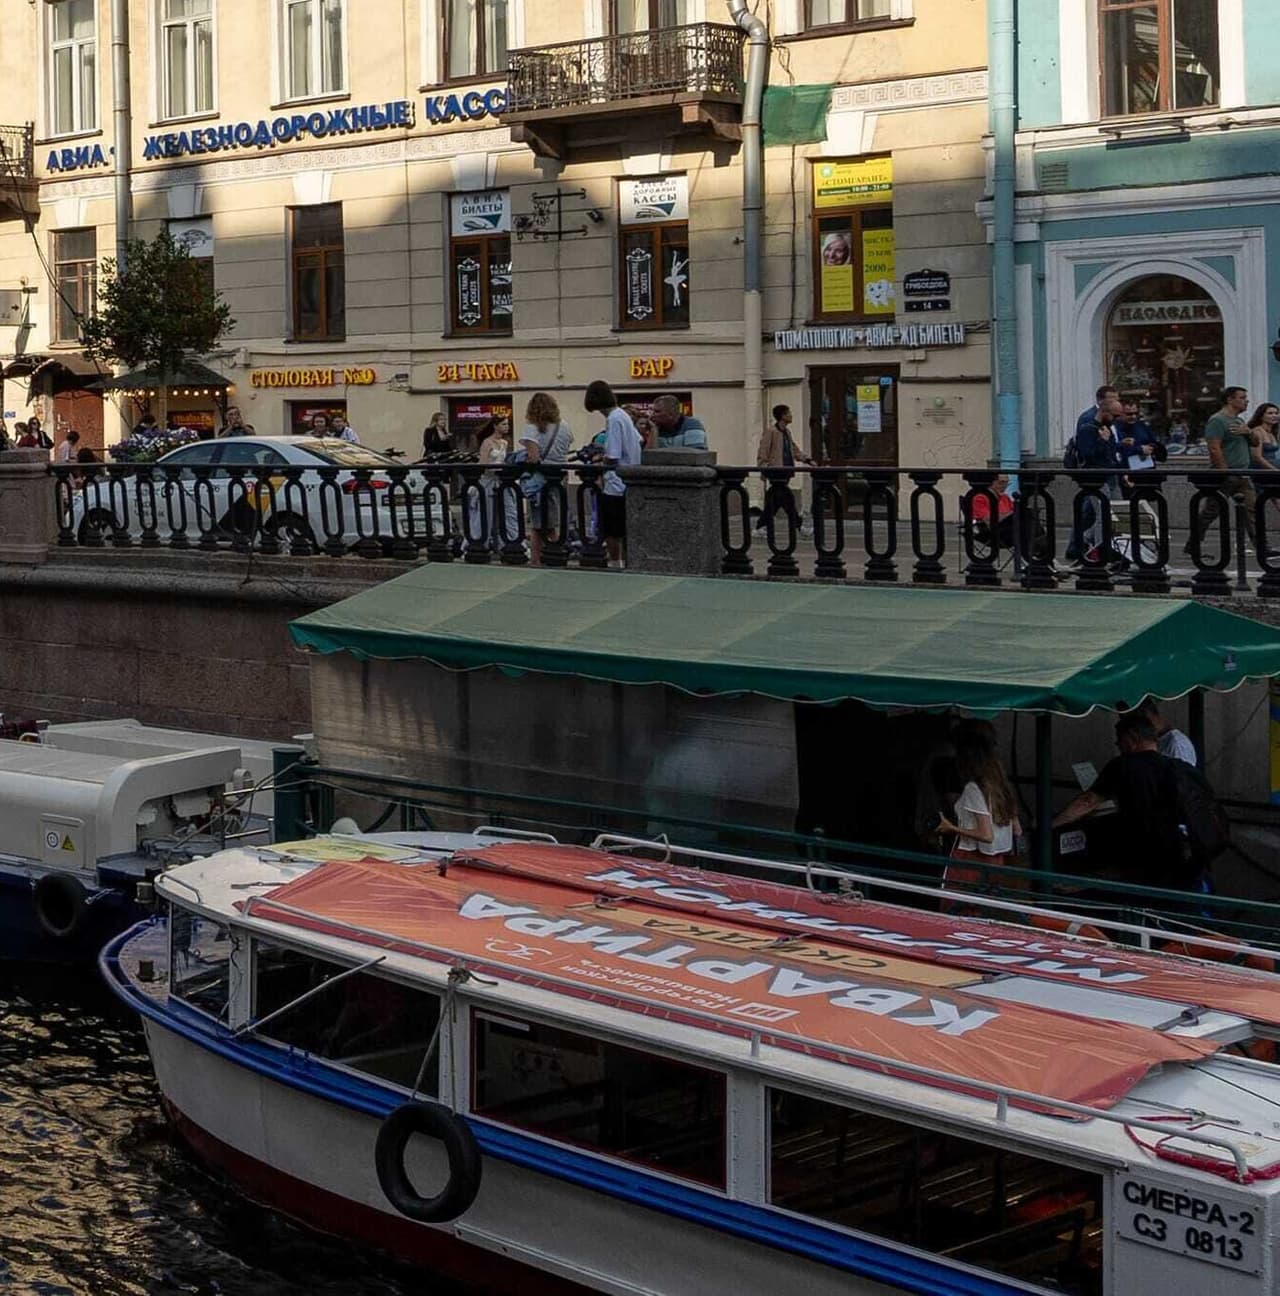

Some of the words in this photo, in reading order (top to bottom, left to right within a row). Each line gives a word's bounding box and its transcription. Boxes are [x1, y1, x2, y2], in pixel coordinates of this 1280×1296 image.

[143, 100, 415, 160] ЖЕЛЕЗНОДОРОЖНЫЕ
[462, 193, 503, 205] АВИА
[462, 203, 503, 215] БИЛЕТЫ
[633, 193, 677, 205] КАССЫ
[923, 302, 932, 310] 14
[774, 328, 855, 350] СТОМАТОЛОГИЯ
[919, 324, 965, 345] БИЛЕТЫ
[249, 367, 335, 388] СТОЛОВАЯ
[437, 363, 460, 383] 24
[465, 360, 520, 382] ЧАСА
[629, 356, 674, 378] БАР
[585, 870, 1150, 983] МИЛЛИОН
[643, 919, 887, 968] СКИДКА
[459, 894, 1001, 1037] КВАРТИРА
[1123, 1181, 1255, 1236] СИЕРРА-2
[1185, 1227, 1244, 1261] 0813
